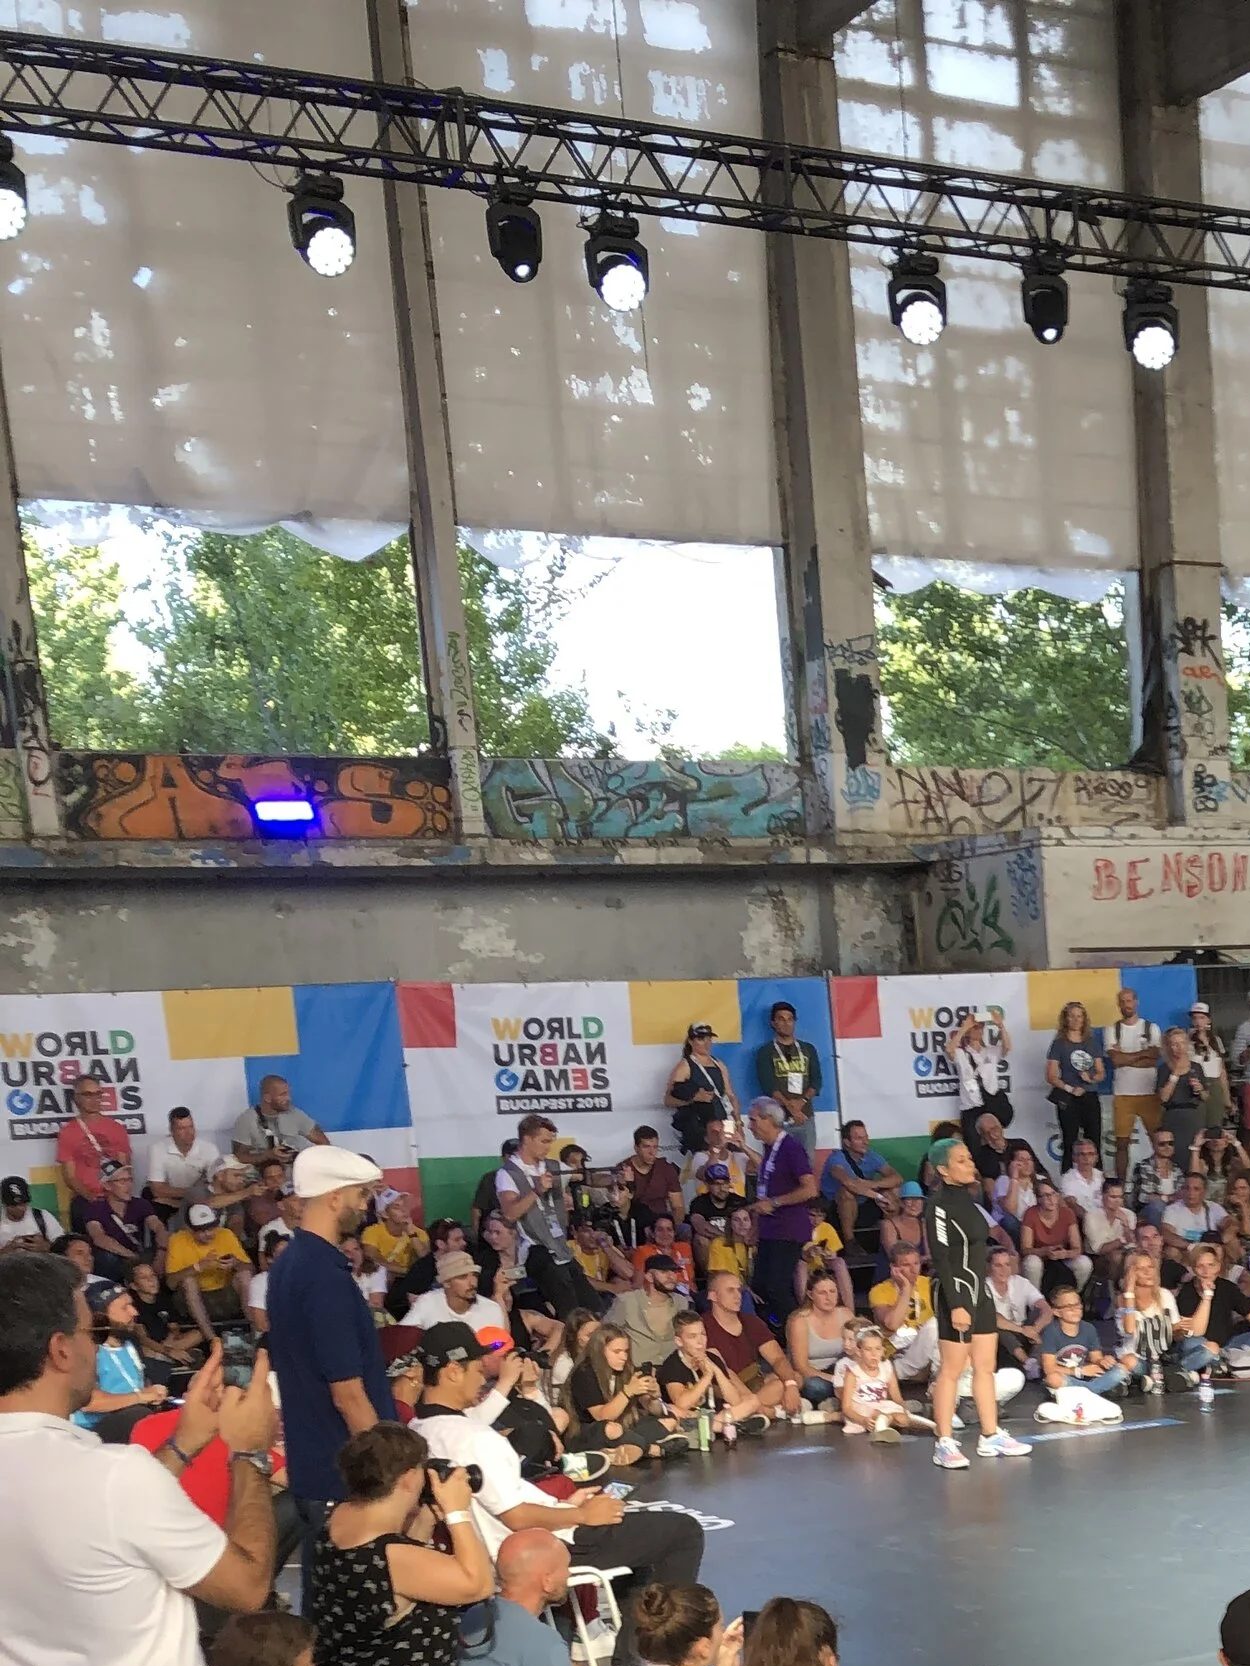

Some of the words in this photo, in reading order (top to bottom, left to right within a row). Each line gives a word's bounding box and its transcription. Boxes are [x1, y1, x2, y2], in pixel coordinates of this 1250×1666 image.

[1093, 851, 1249, 901] BENSON
[491, 1016, 604, 1040] WORLD
[0, 1030, 135, 1059] WORLD
[493, 1042, 607, 1066] URBAN
[496, 1067, 610, 1092] GAMES
[500, 1098, 575, 1111] BUDAPEST
[577, 1096, 609, 1109] 2019
